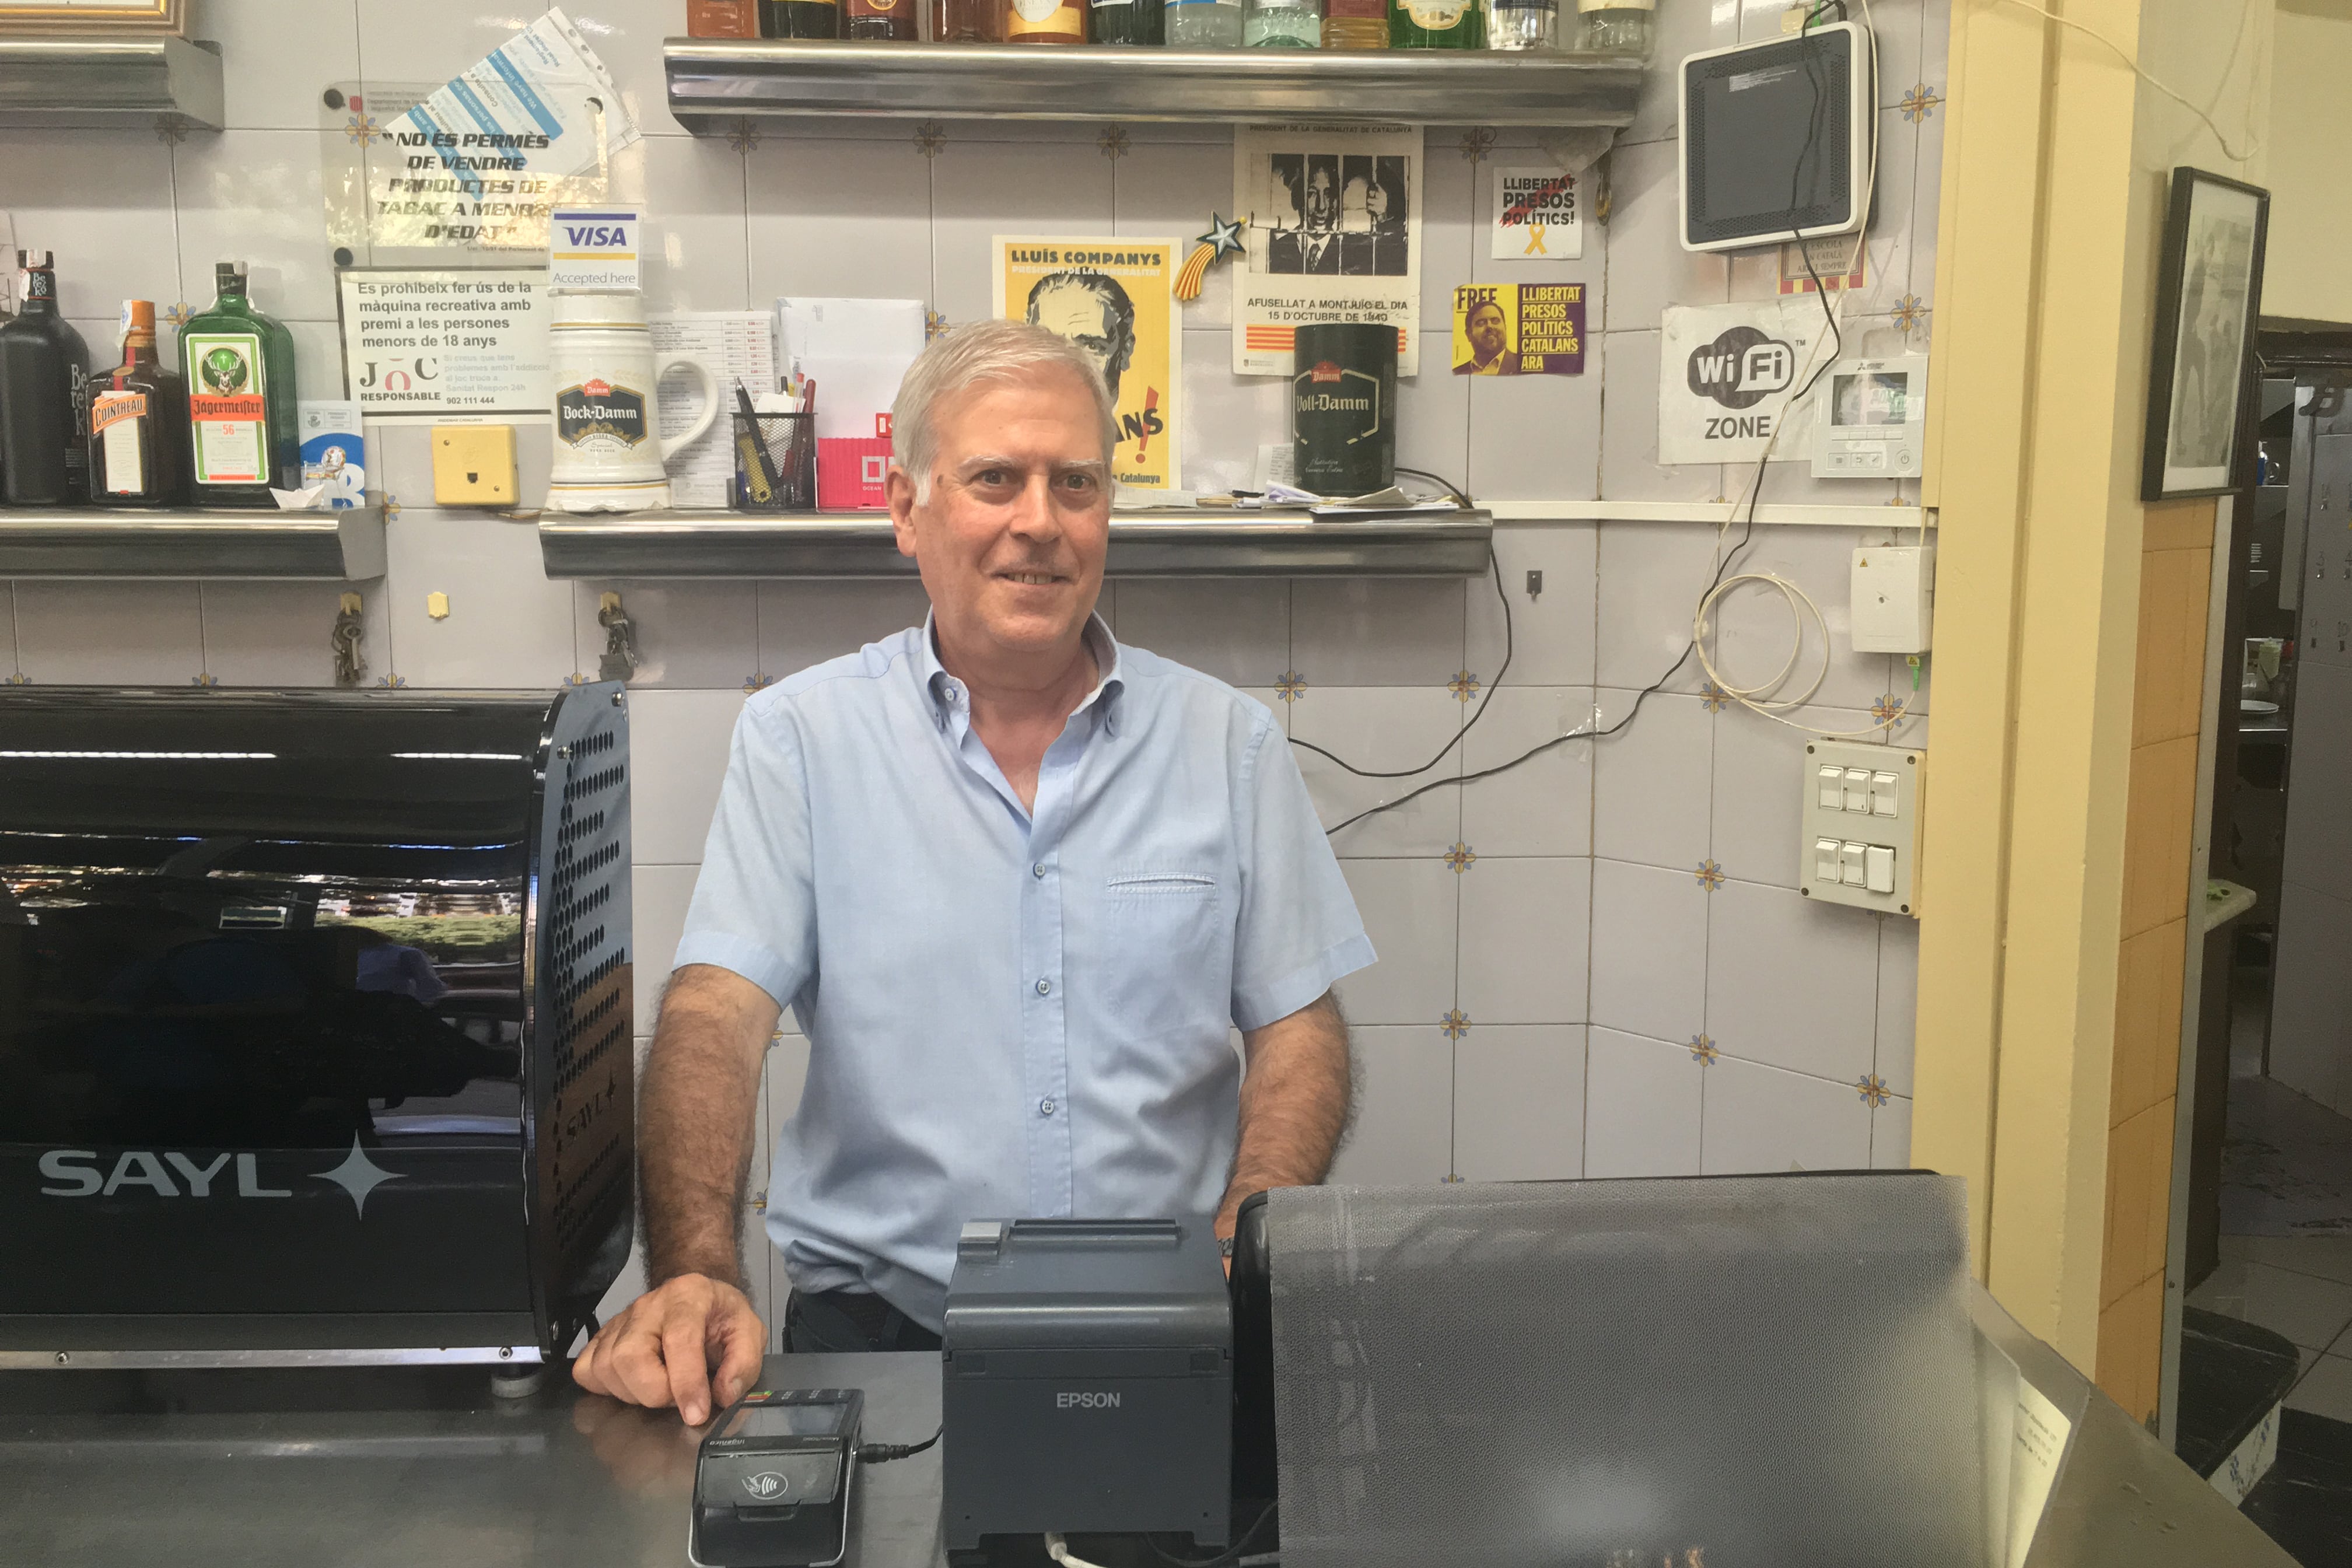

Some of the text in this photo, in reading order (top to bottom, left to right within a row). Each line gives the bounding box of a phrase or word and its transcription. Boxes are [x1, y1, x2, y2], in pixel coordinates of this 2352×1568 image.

[512, 80, 528, 99] have
[461, 89, 489, 123] personas
[462, 131, 551, 148] PERMÈS
[407, 155, 527, 171] DE VENDRE
[518, 179, 548, 195] DE
[1503, 177, 1576, 191] LLIBERTAT
[1503, 192, 1575, 208] PRESOS
[377, 201, 447, 215] TABAC
[450, 202, 466, 216] A
[1503, 211, 1575, 226] POLÍTICS!
[562, 226, 627, 247] VISA
[1012, 249, 1161, 265] LLUÍS COMPANYS
[553, 273, 635, 285] Accepted here
[1082, 267, 1094, 275] LA
[358, 281, 531, 297] Es prohibeix fer ús de la
[1522, 286, 1581, 302] LLIBERTAT
[359, 298, 531, 314] màquina recreativa amb
[1248, 298, 1306, 309] AFUSELLAT
[1309, 300, 1316, 309] A
[1458, 288, 1497, 310] FREE
[1268, 312, 1279, 320] 15
[1283, 312, 1342, 321] D'OCTUBRE
[1346, 313, 1359, 321] DE
[1522, 304, 1566, 318] PRESOS
[361, 317, 510, 332] premi a les persones
[1522, 320, 1573, 336] POLÍTICS
[362, 334, 497, 349] menors de 18 anys
[1521, 338, 1578, 353] CATALANS
[1521, 356, 1544, 370] ARA
[71, 363, 87, 390] Be
[1312, 371, 1340, 381] Damm
[360, 392, 441, 401] RESPONSABLE
[1296, 394, 1370, 412] Voll-Damm
[95, 398, 143, 426] COINTREAU
[563, 405, 637, 419] Bock-Damm
[223, 424, 235, 435] 56
[1704, 416, 1771, 439] ZONE
[1121, 473, 1160, 484] Catalunya
[39, 1150, 292, 1197] SAYL
[1056, 1392, 1121, 1408] EPSON
